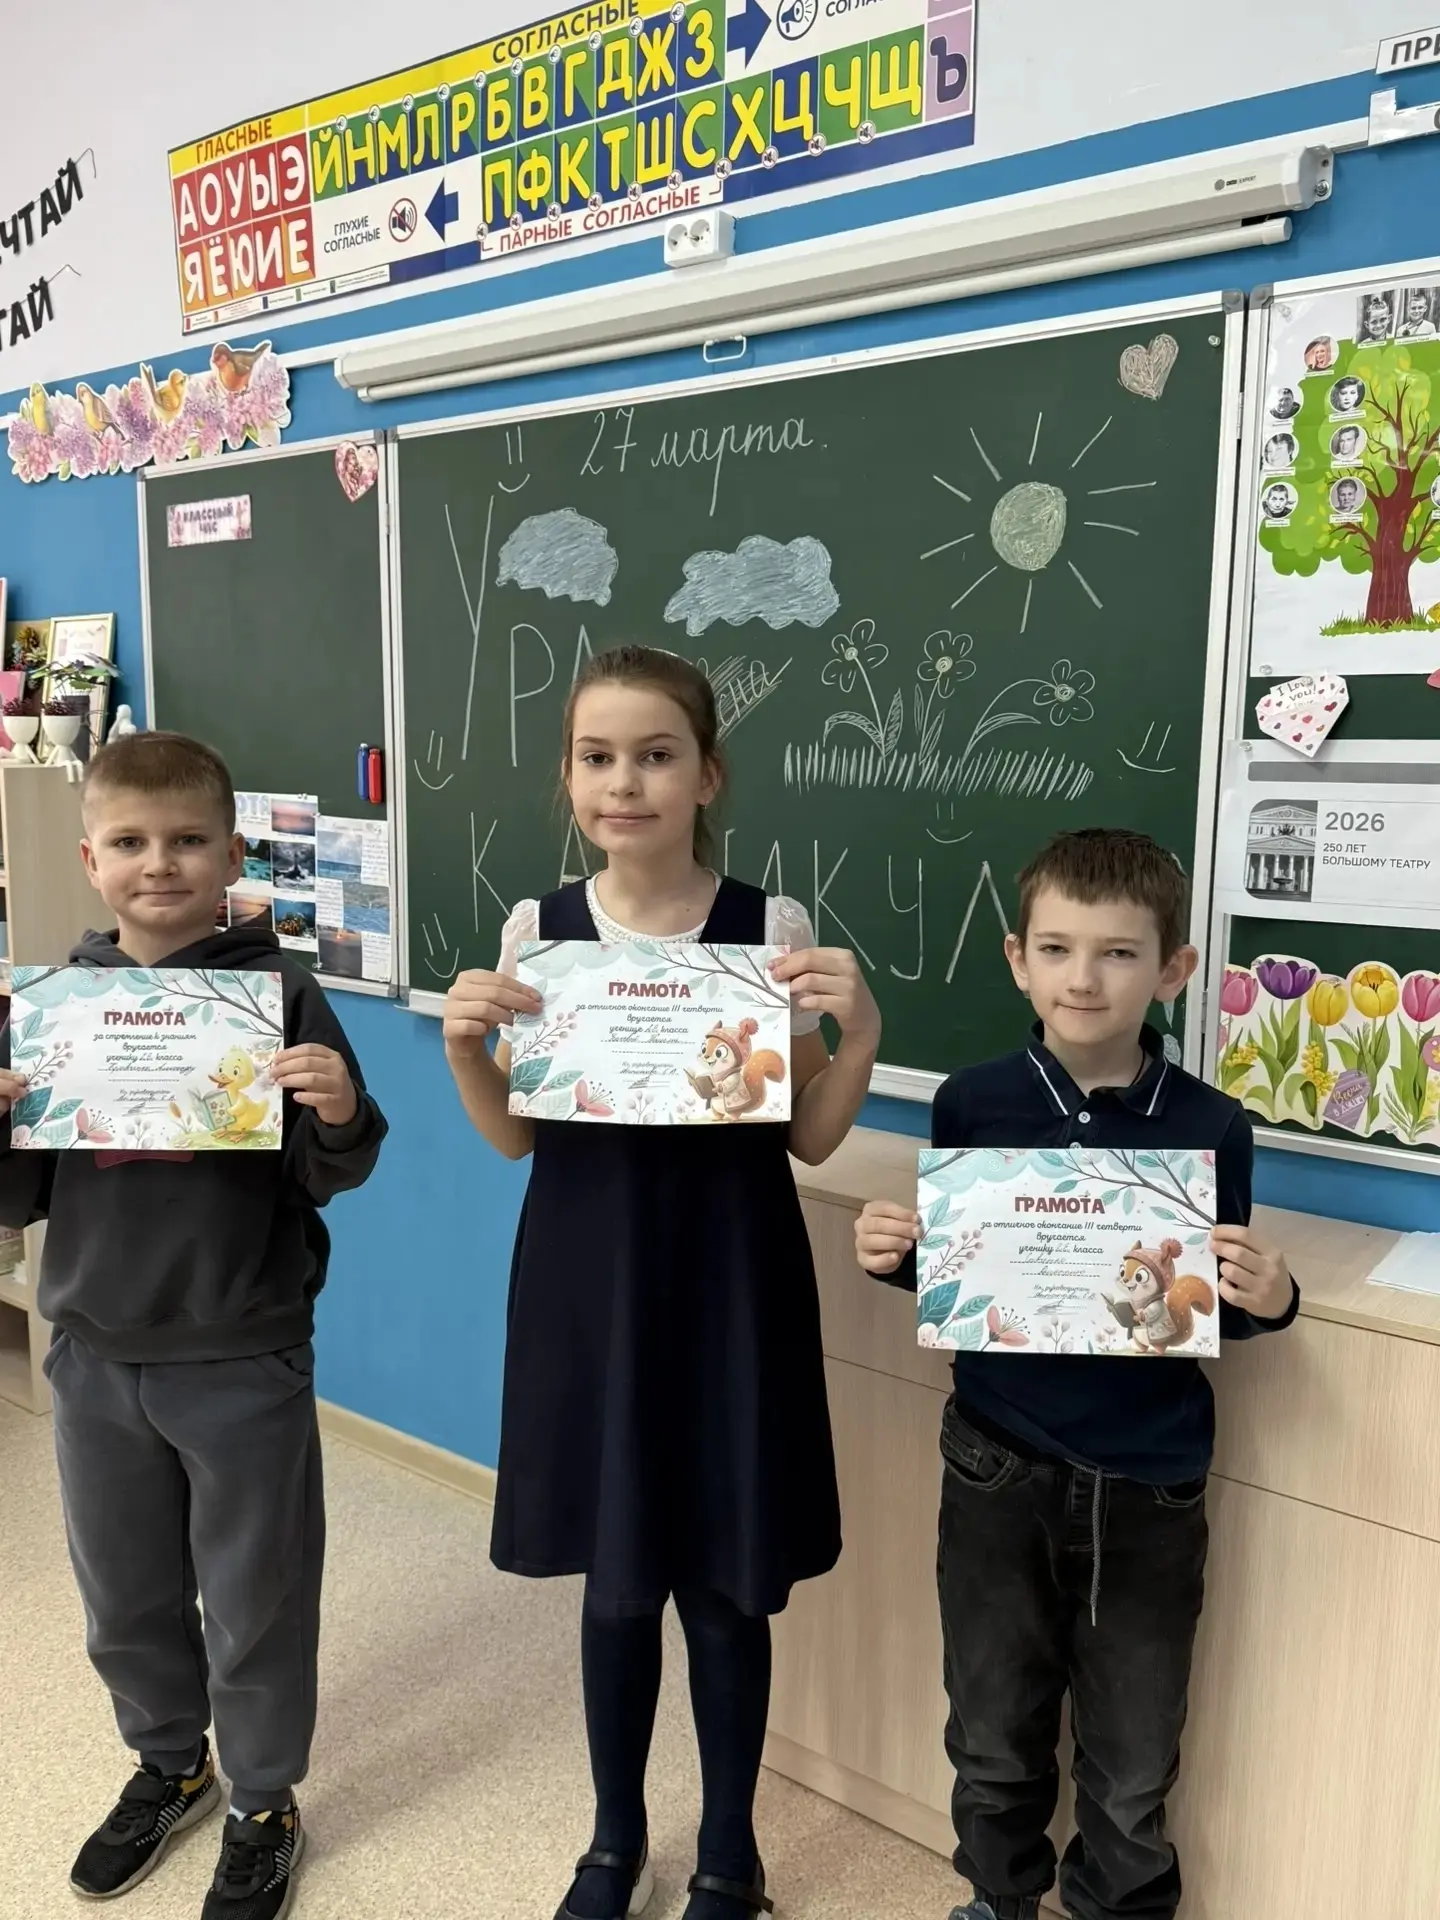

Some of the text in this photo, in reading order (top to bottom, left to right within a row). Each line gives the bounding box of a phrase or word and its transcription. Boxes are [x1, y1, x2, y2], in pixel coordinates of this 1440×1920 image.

[493, 0, 639, 63] СОГЛАСНЫЕ
[196, 118, 273, 164] ГЛАСНЫЕ
[0, 157, 84, 256] ЧТАЙ
[334, 214, 369, 236] ГЛУХИЕ
[500, 186, 700, 252] ПАРНЫЕ СОГЛАСНЫЕ
[323, 227, 381, 254] СОГЛАСНЫЕ
[580, 407, 637, 476] 27
[1287, 677, 1312, 692] Lov
[1325, 811, 1385, 832] 2026
[1323, 843, 1367, 853] 250 ЛЕТ
[1322, 856, 1431, 869] БОЛЬШОМУ ТЕАТРУ
[608, 981, 692, 998] ГРАМОТА
[575, 1004, 586, 1012] за
[588, 1004, 627, 1012] отличное
[628, 1003, 670, 1012] окончание
[683, 1004, 724, 1014] четверти
[104, 1011, 187, 1026] ГРАМОТА
[626, 1013, 673, 1023] вручается
[660, 1025, 689, 1034] класса
[1014, 1197, 1106, 1214] ГРАМОТА
[981, 1221, 992, 1230] за
[993, 1221, 1035, 1229] отличное
[1036, 1220, 1083, 1230] окончание
[1096, 1222, 1143, 1233] четверти
[1036, 1232, 1087, 1243] вручается
[1018, 1244, 1054, 1254] ученику
[1072, 1245, 1104, 1254] класса
